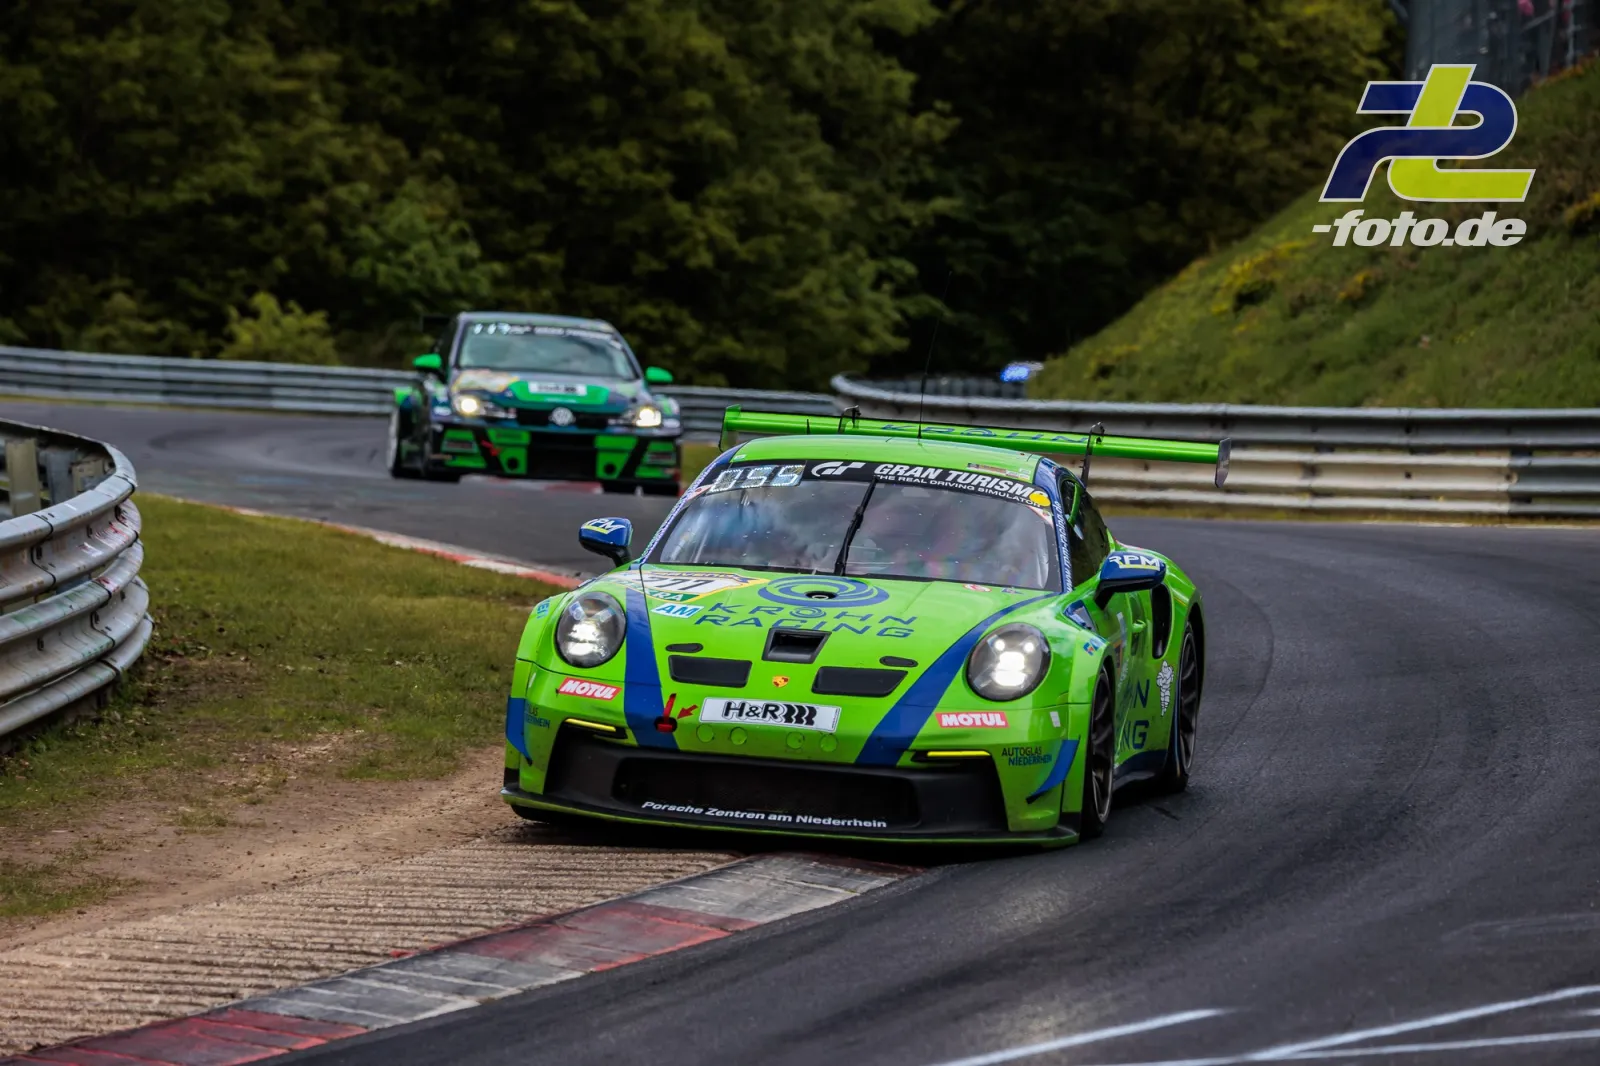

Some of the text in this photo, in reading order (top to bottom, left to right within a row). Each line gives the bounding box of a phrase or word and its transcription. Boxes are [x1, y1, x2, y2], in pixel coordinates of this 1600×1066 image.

[873, 463, 943, 480] GRAN
[897, 476, 927, 485] REAL
[929, 480, 975, 491] DRIVING
[977, 487, 1041, 508] SIMULATOR
[656, 603, 701, 617] AM
[708, 602, 918, 625] KROHN
[694, 614, 915, 638] RACING
[559, 679, 617, 699] MOTUL
[723, 701, 780, 720] H&R
[940, 713, 1006, 727] MOTUL
[641, 801, 888, 828] Porsche Zentren am Niederrhein
